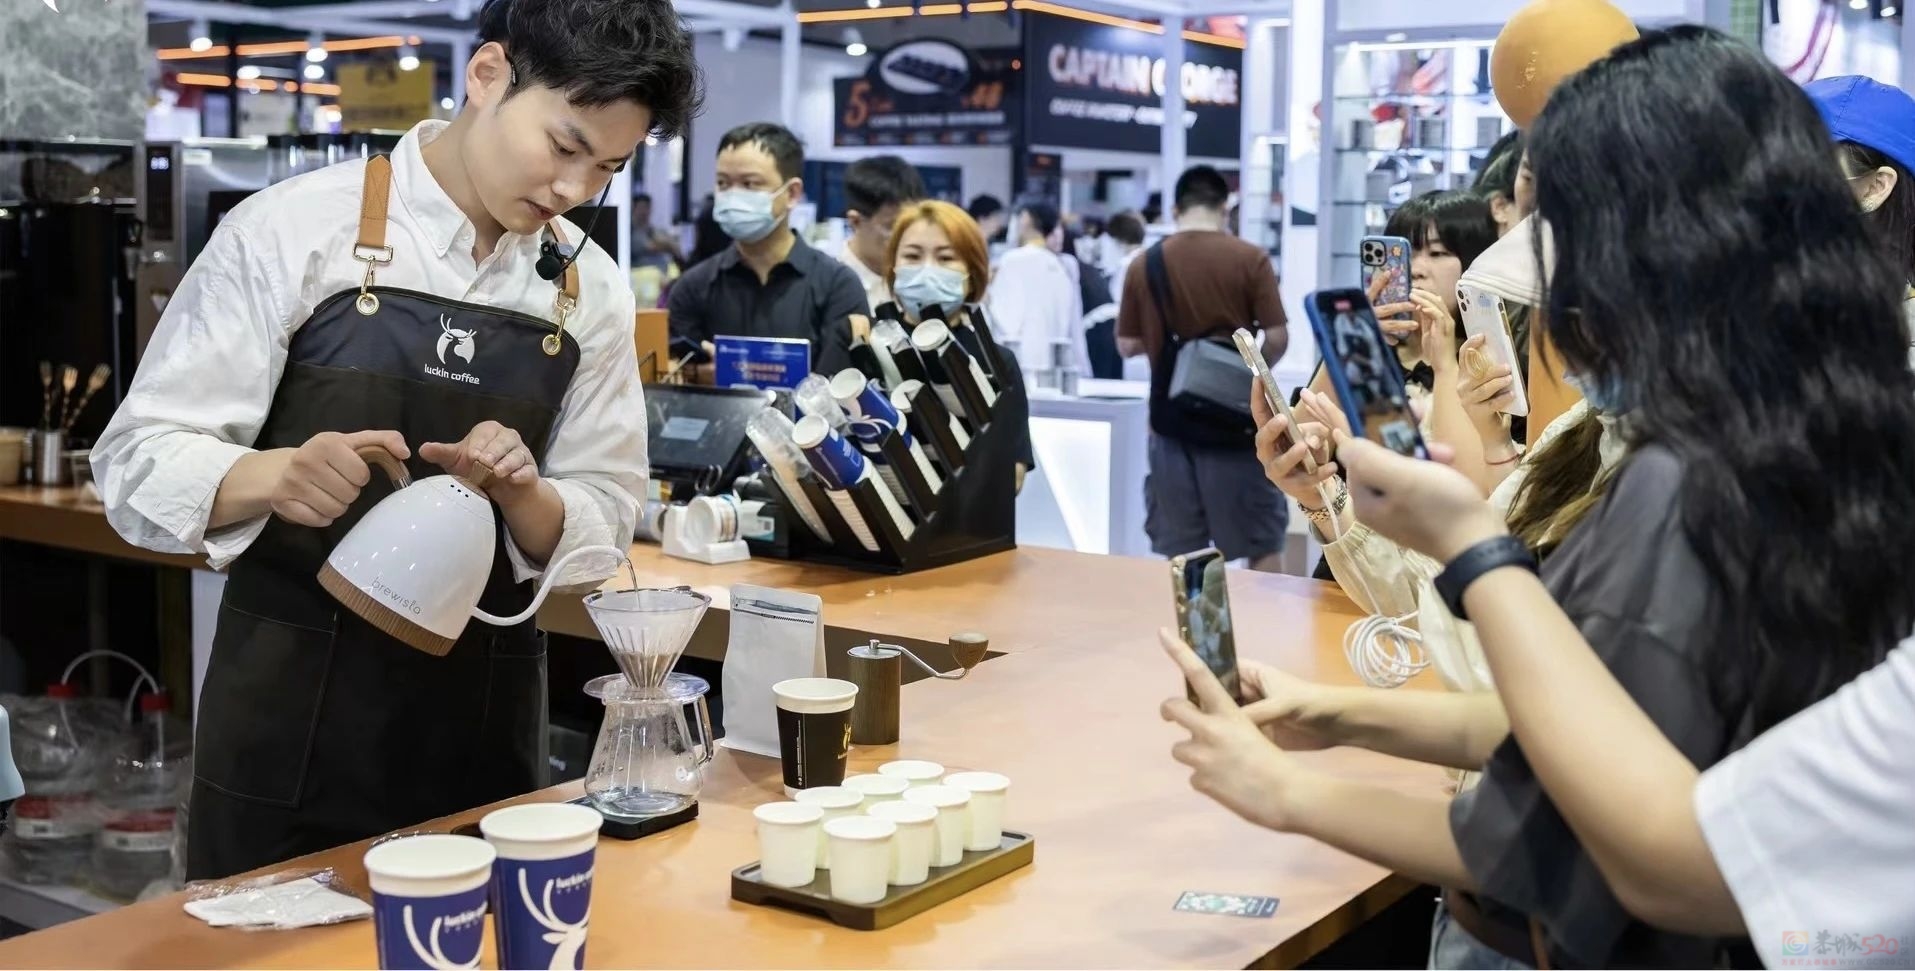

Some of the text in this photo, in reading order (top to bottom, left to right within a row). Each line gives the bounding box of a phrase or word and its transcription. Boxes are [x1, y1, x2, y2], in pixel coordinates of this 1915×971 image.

[1048, 43, 1151, 96] CAPTAIN
[424, 363, 480, 385] luckin coffee
[371, 576, 421, 615] brewista
